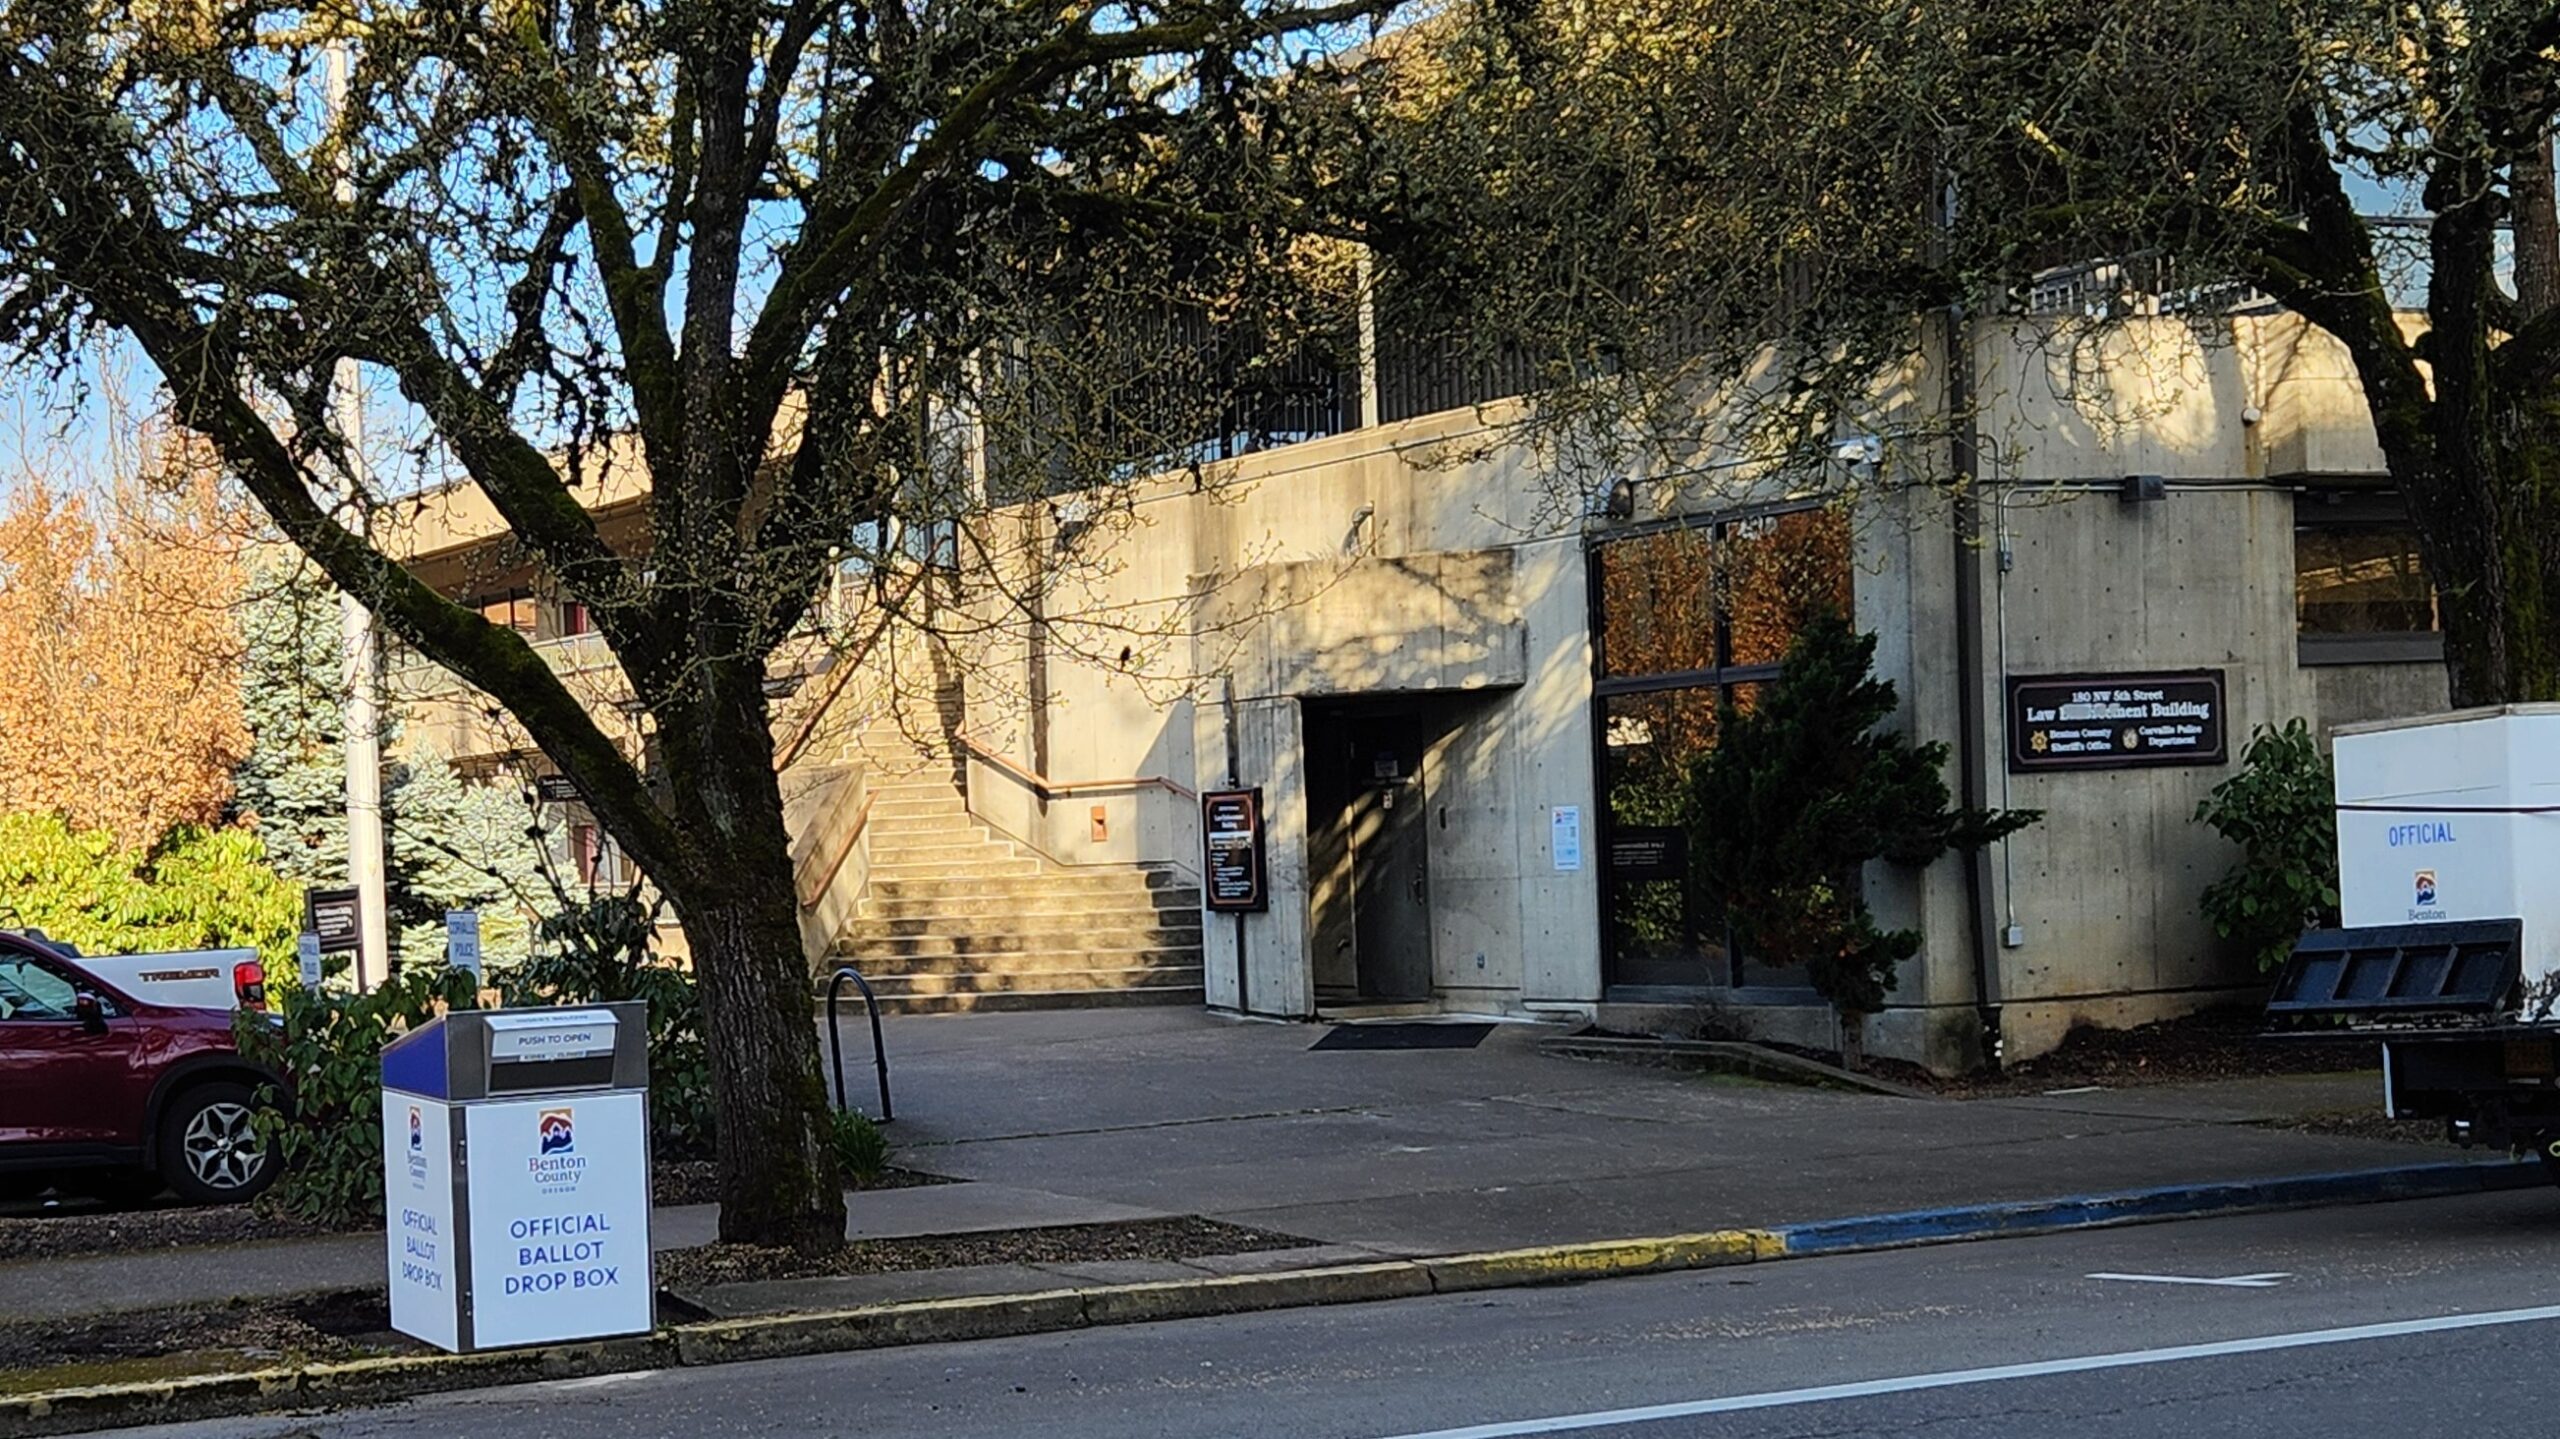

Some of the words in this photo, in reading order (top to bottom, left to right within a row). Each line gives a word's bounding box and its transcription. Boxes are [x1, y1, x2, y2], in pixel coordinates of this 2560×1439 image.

[2072, 691, 2092, 702] 180
[2093, 690, 2112, 702] NW
[2113, 689, 2131, 701] 5th
[2133, 689, 2164, 701] Street
[2027, 707, 2057, 722] Law
[2151, 701, 2210, 720] Building
[2389, 822, 2456, 847] OFFICIAL
[2408, 909, 2447, 921] Benton
[519, 1036, 545, 1046] PUSH
[549, 1035, 562, 1044] TO
[563, 1032, 592, 1042] OPEN
[528, 1157, 587, 1172] Benton
[534, 1170, 582, 1184] County
[402, 1208, 438, 1236] OFFICIAL
[510, 1213, 611, 1239] OFFICIAL
[406, 1235, 436, 1262] BALLOT
[519, 1241, 604, 1266] BALLOT
[402, 1261, 423, 1284] DROP
[424, 1268, 442, 1291] BOX
[505, 1272, 567, 1295] DROP
[573, 1266, 619, 1288] BOX
